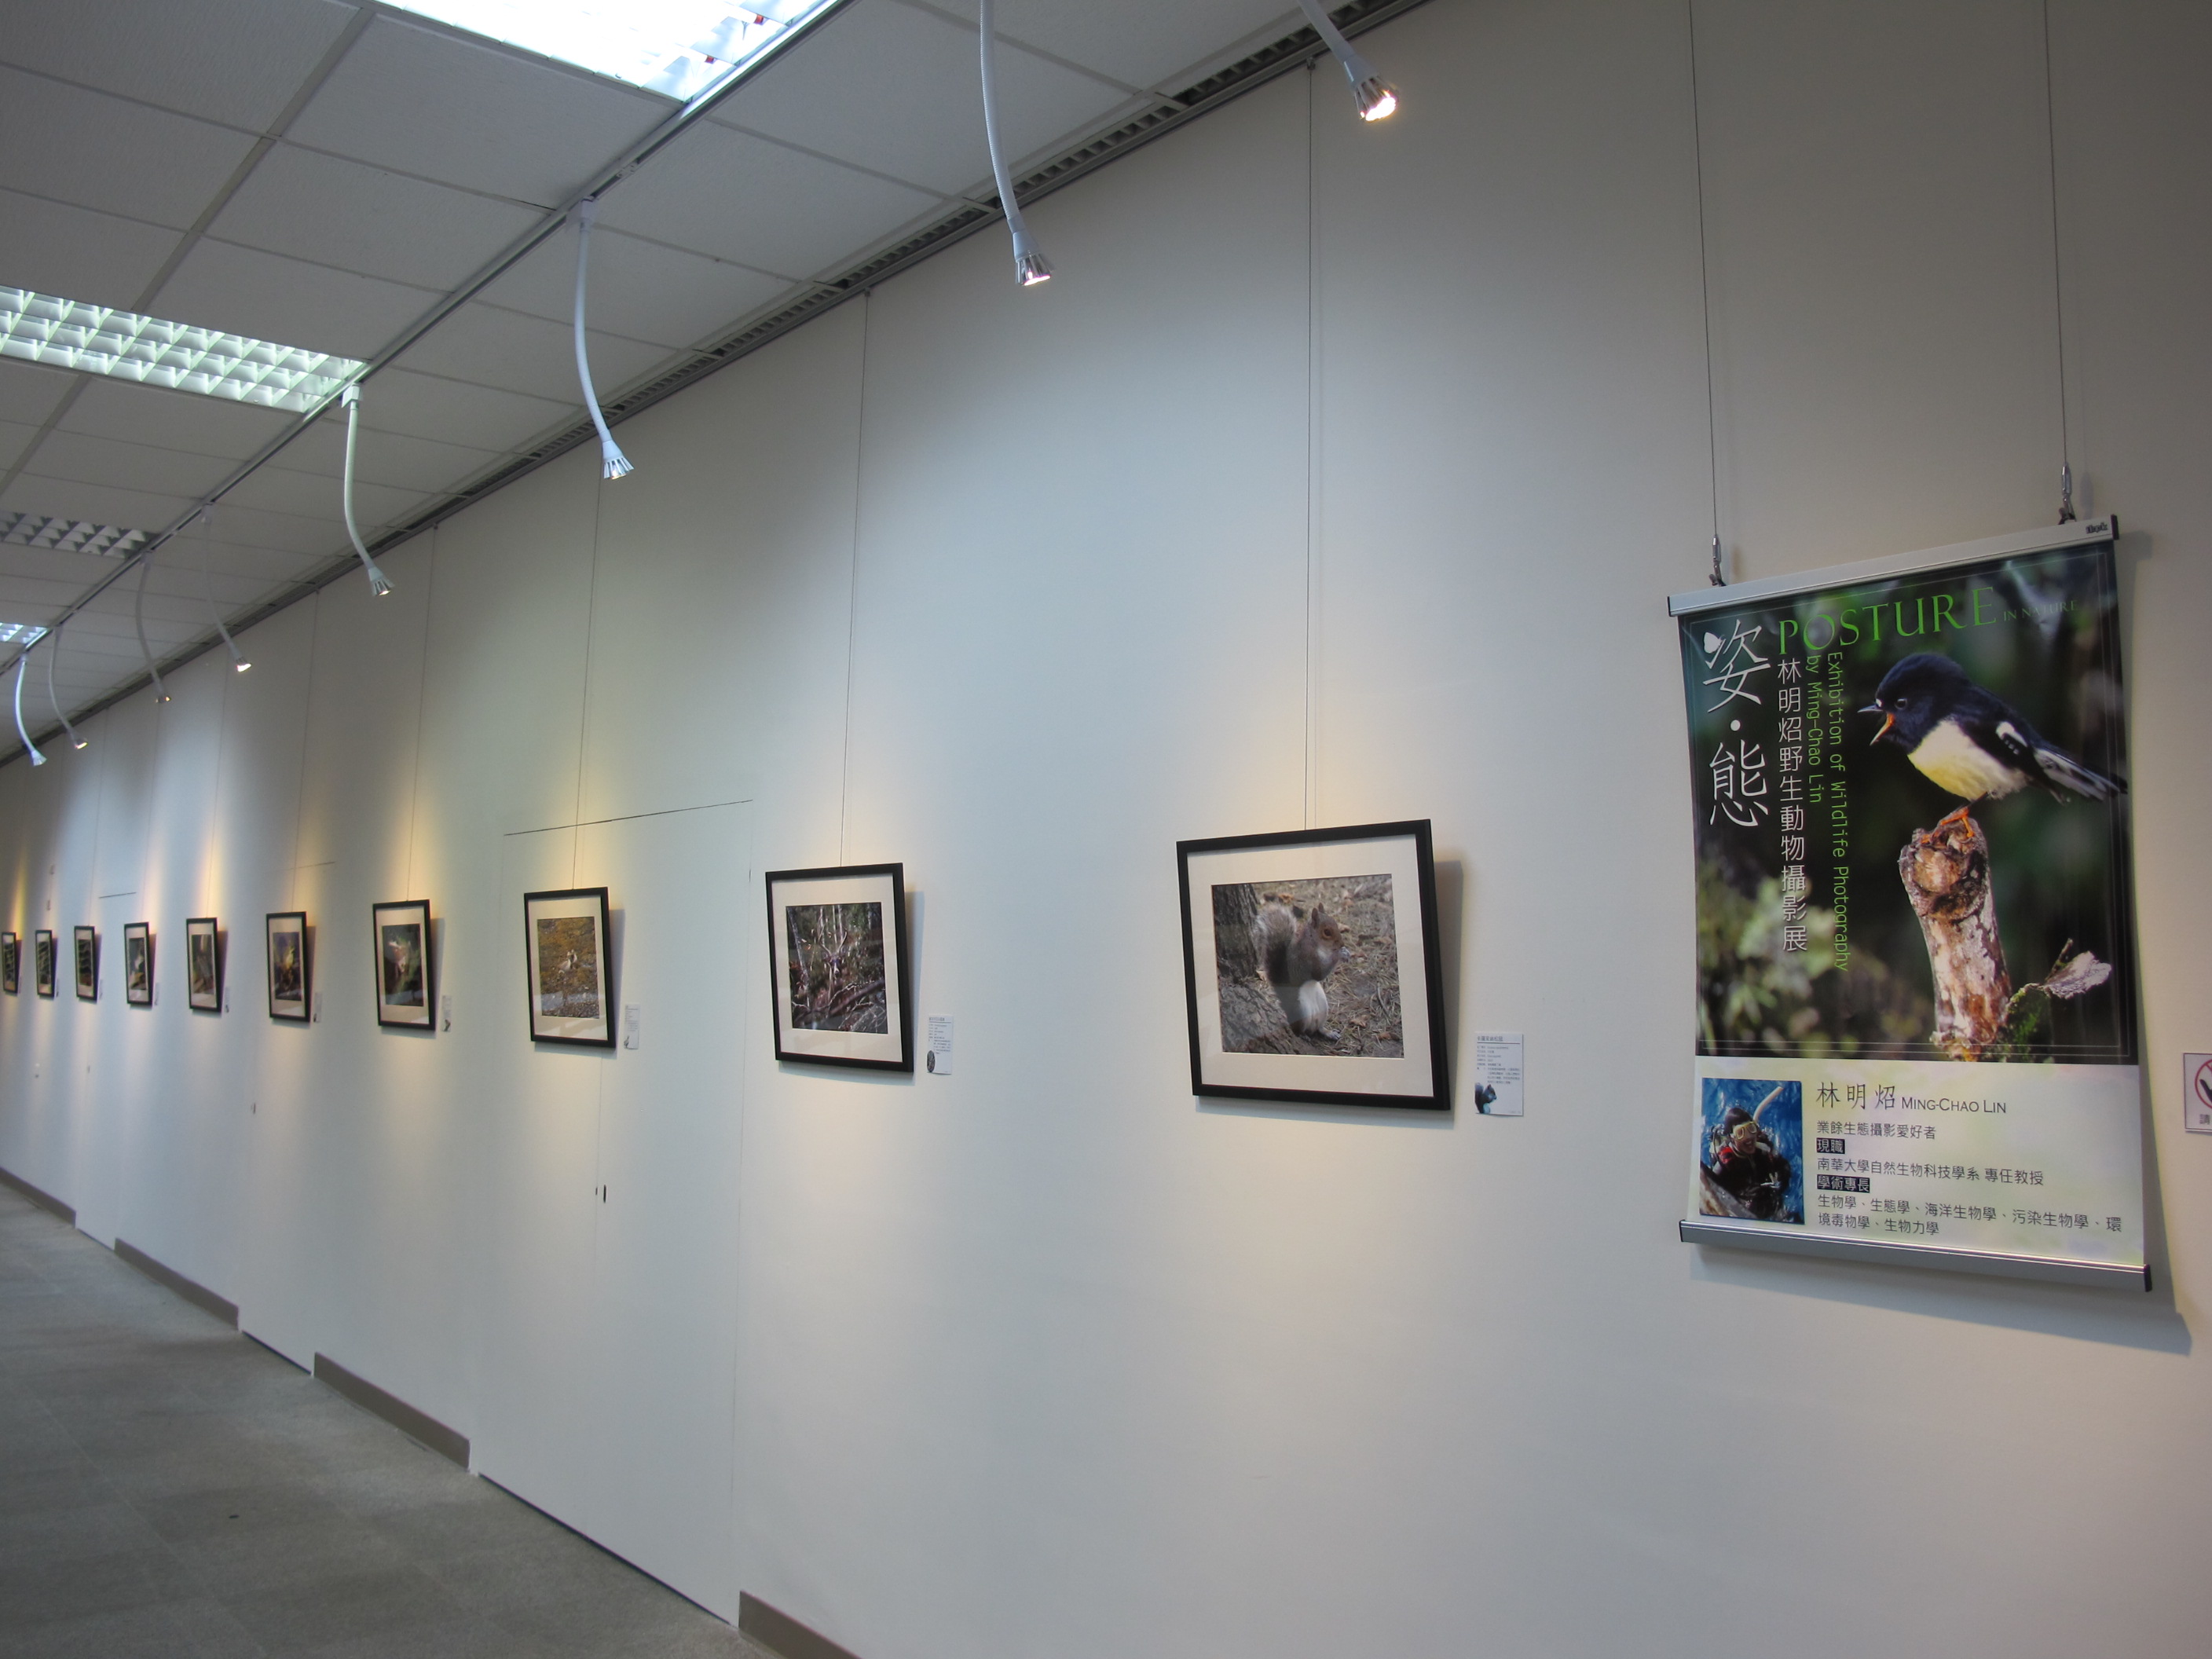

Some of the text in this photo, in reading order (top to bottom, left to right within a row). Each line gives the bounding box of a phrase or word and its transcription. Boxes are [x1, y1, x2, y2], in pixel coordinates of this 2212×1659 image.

[1778, 587, 2078, 655] POSTURE IN NATURE
[1806, 654, 1824, 804] by Ming-Chao Lin
[1778, 657, 1807, 952] 林明炤野生動物攝影展
[1827, 651, 1851, 972] Exhibition of Wildlife Photography
[1817, 1120, 1936, 1140] 業餘生態攝影愛好者
[1818, 1139, 1844, 1153] 現職
[1818, 1157, 2044, 1186] 南華大學自然生物科技學系 專任教授
[1818, 1176, 1870, 1192] 學術專長
